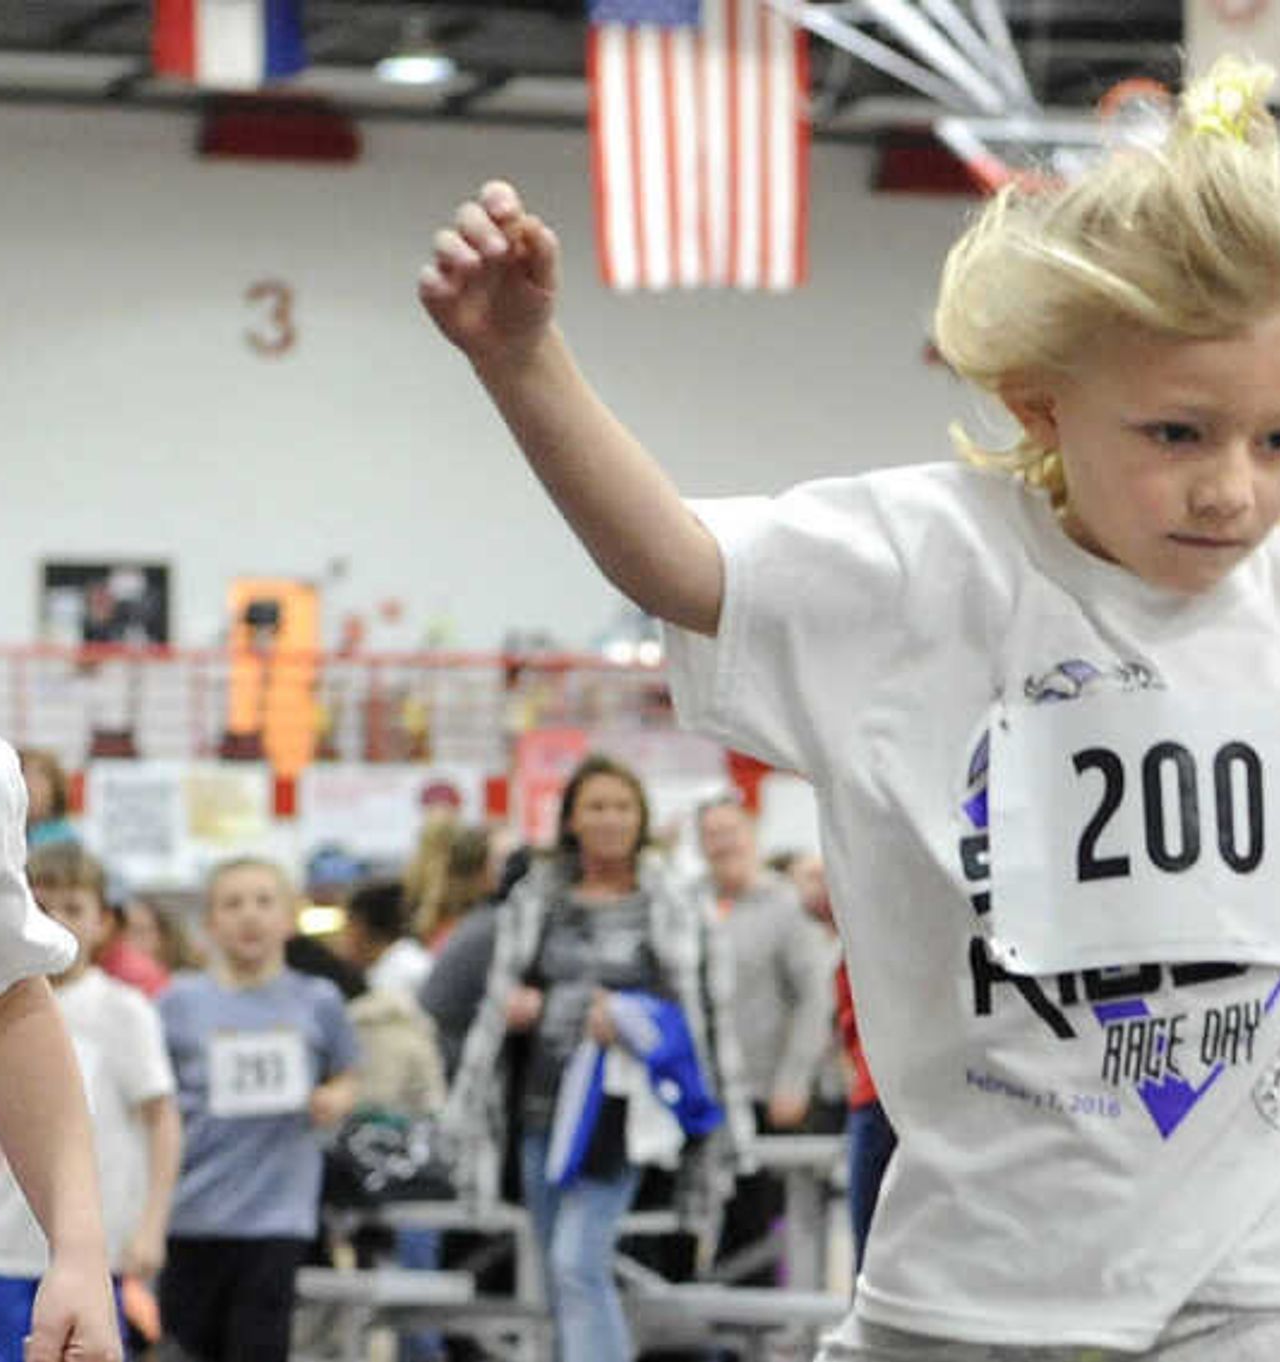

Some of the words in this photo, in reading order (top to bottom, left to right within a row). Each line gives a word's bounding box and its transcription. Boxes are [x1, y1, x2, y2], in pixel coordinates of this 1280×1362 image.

[243, 278, 297, 359] 3
[1072, 740, 1265, 883] 200
[1200, 999, 1262, 1067] DAY
